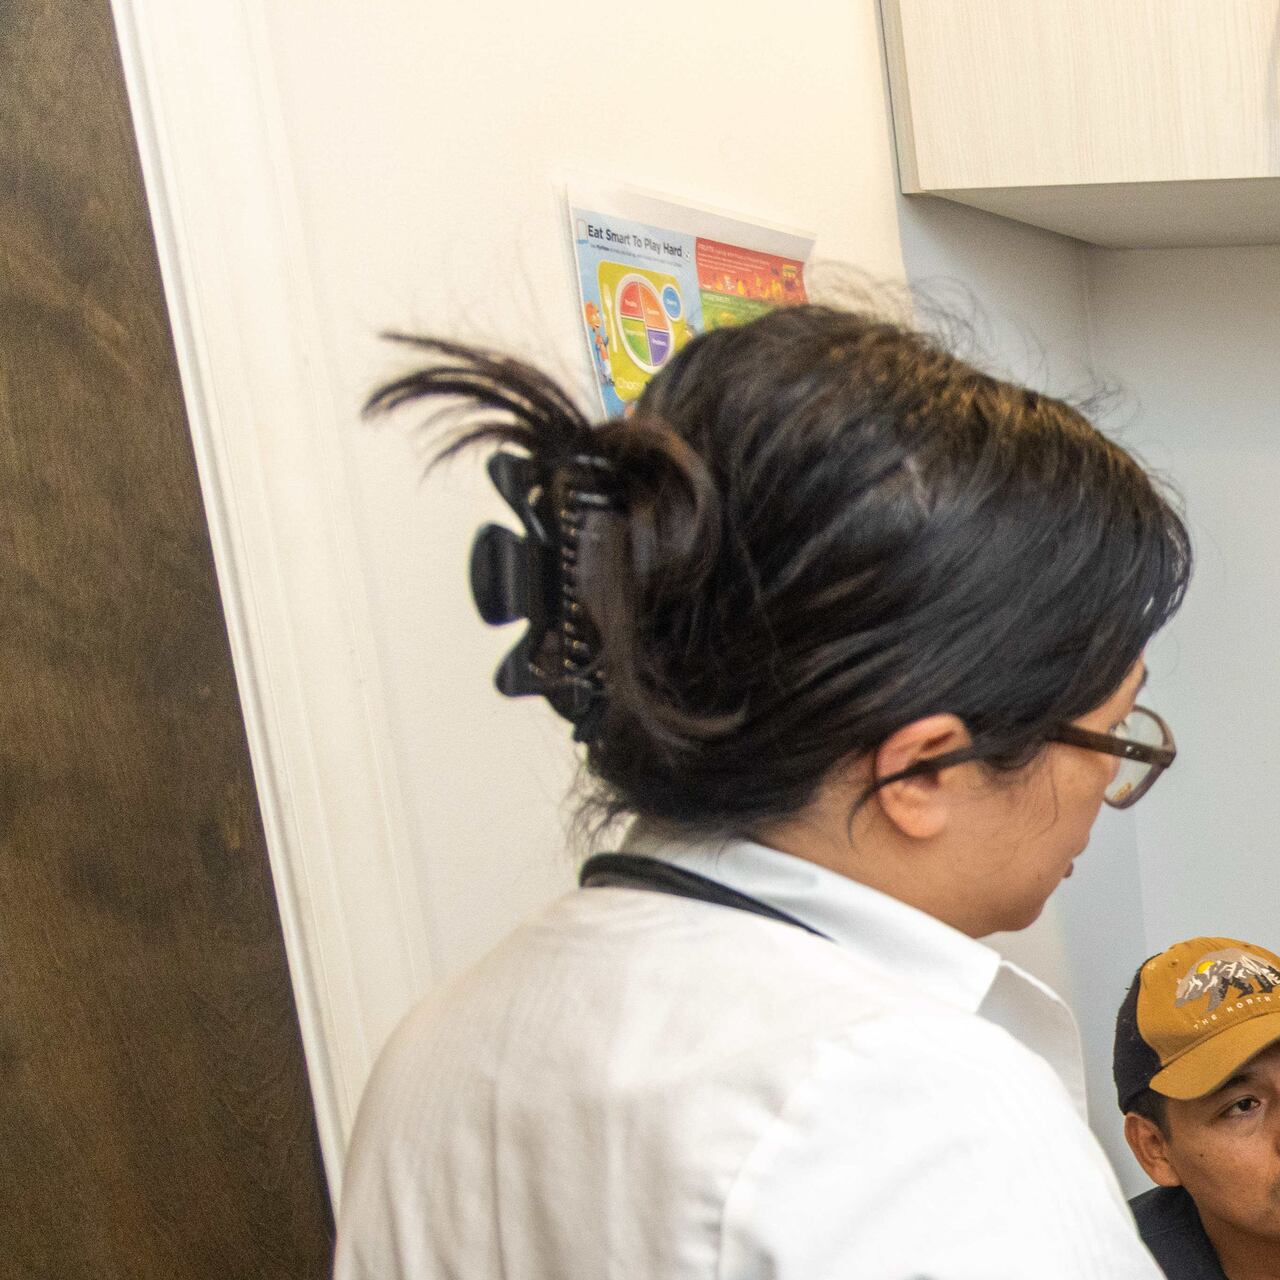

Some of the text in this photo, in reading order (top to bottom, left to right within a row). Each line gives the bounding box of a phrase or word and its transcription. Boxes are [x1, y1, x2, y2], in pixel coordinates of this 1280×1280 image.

[587, 224, 604, 240] Eat
[605, 228, 631, 246] Smart
[632, 235, 643, 249] To
[644, 238, 662, 255] Play
[663, 242, 683, 258] Hard
[1193, 1013, 1218, 1030] THE
[1226, 995, 1272, 1013] NORTH
